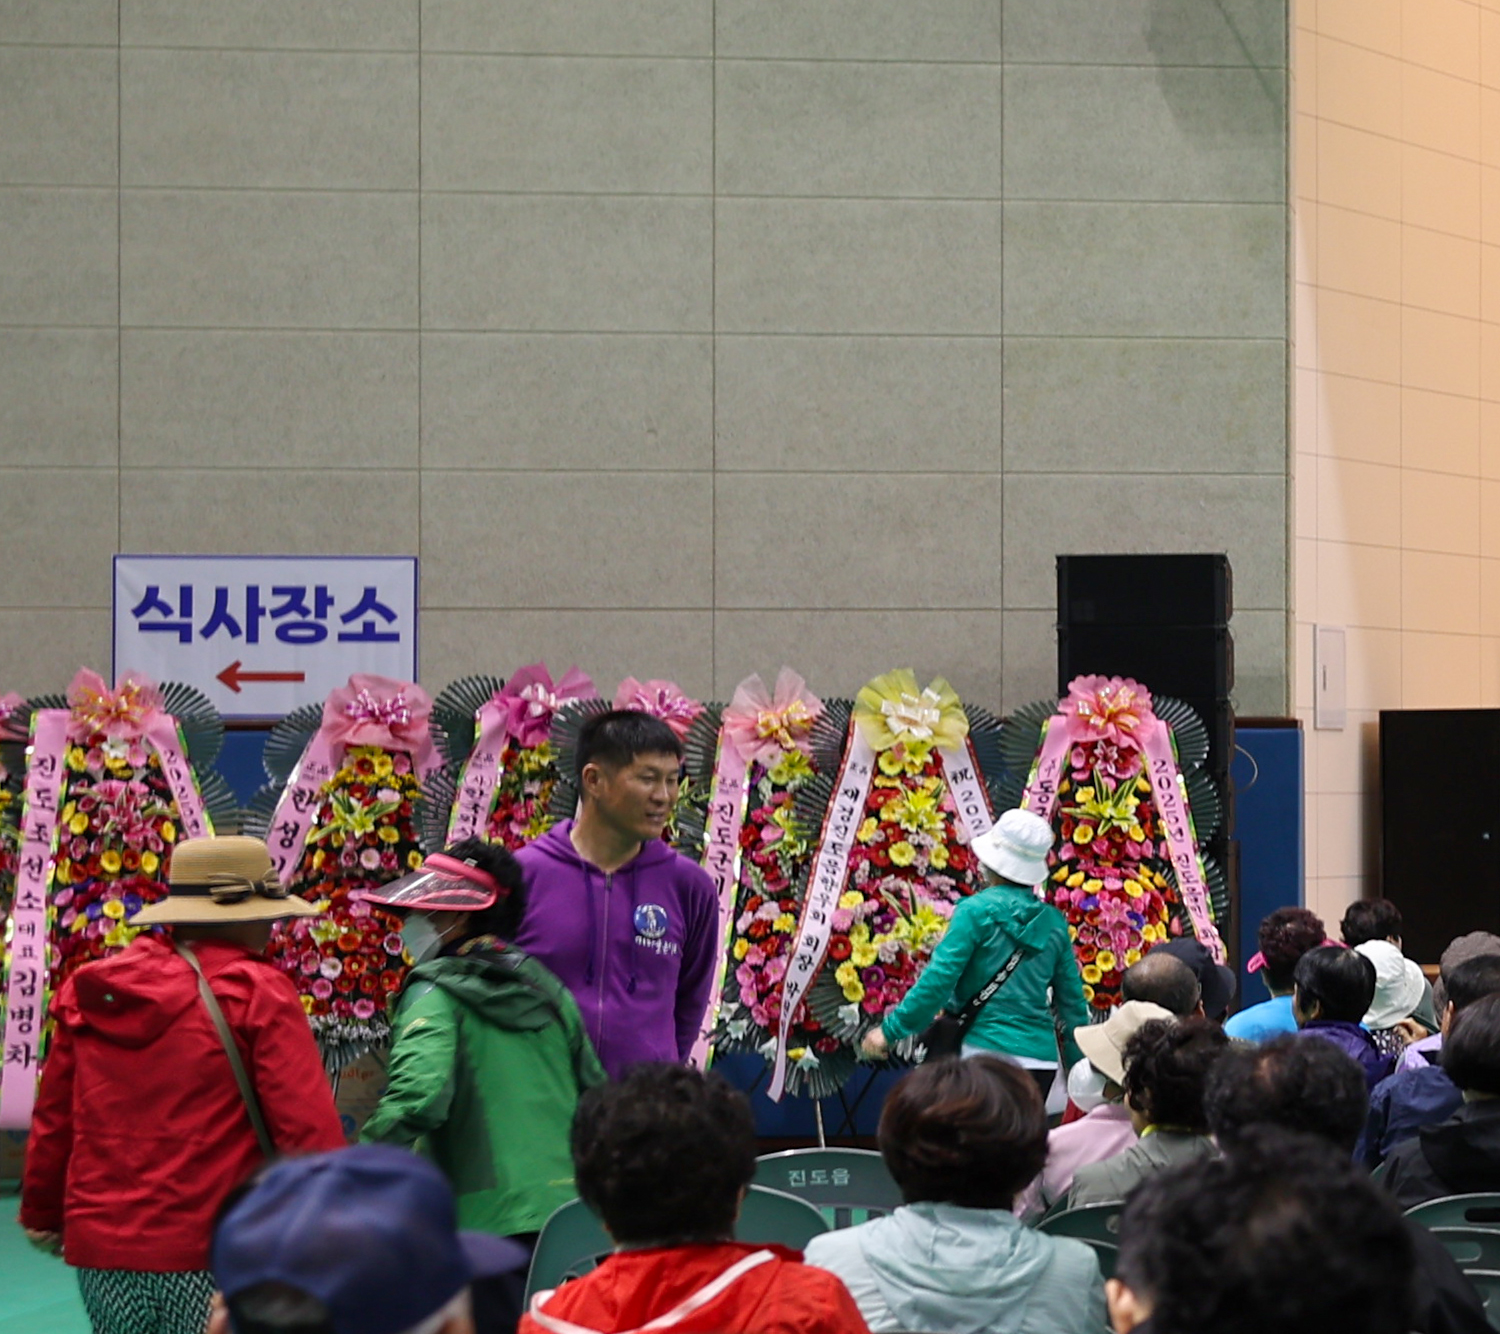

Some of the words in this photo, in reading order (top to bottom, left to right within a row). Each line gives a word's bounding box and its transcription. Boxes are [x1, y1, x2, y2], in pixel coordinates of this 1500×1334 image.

[131, 584, 401, 645] 식사장소
[16, 753, 57, 913] 진도조선소
[16, 921, 37, 959] 대표
[788, 1167, 851, 1187] 진도읍
